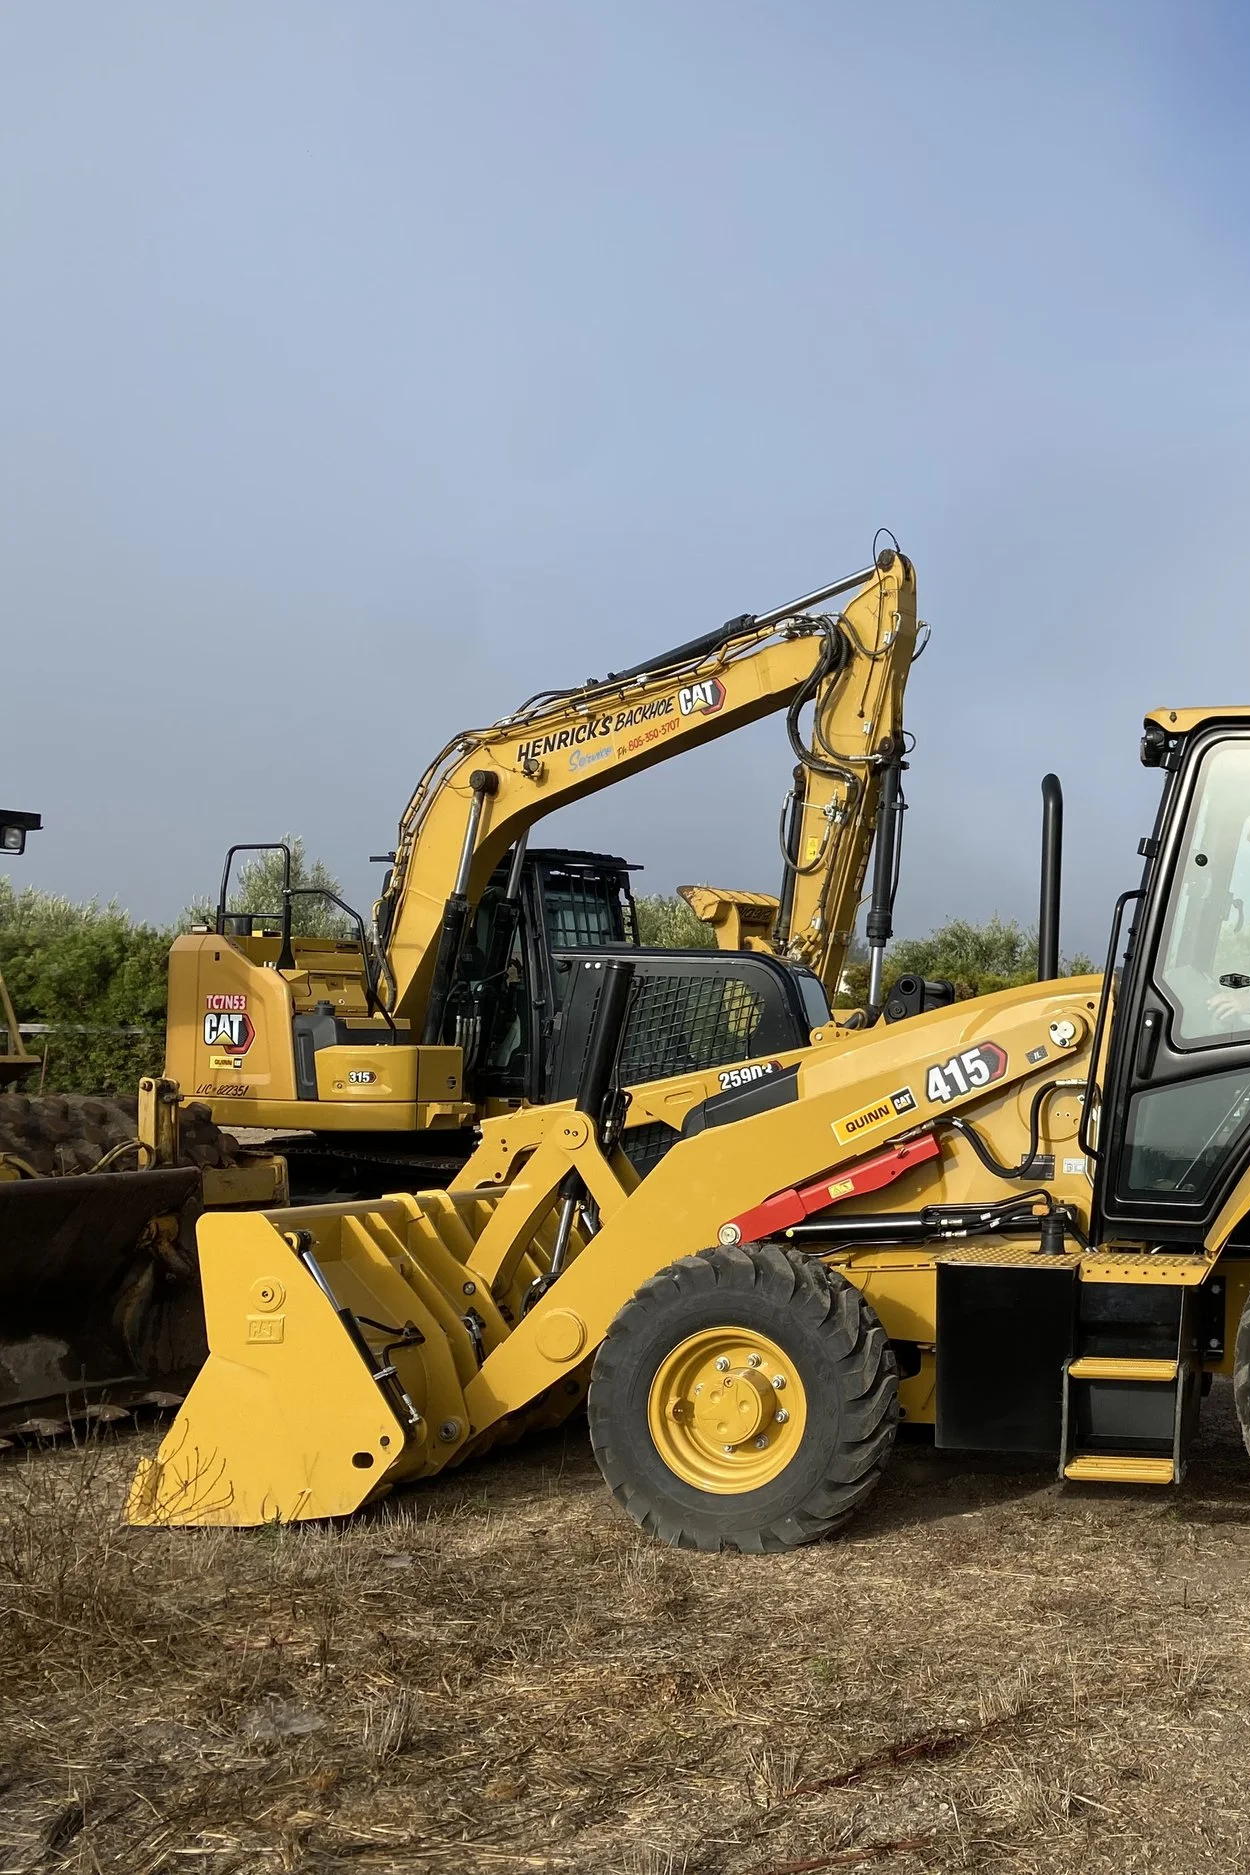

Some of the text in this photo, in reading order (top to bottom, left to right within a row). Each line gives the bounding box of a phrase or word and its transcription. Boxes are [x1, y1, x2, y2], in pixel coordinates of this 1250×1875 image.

[679, 679, 715, 715] CAT
[517, 695, 676, 762] HENRICK'S BACKHOE
[206, 994, 246, 1010] TC7N53
[205, 1013, 243, 1045] CAT
[349, 1071, 370, 1083] 315
[927, 1048, 991, 1103] 415
[845, 1093, 913, 1134] QUINN CAT
